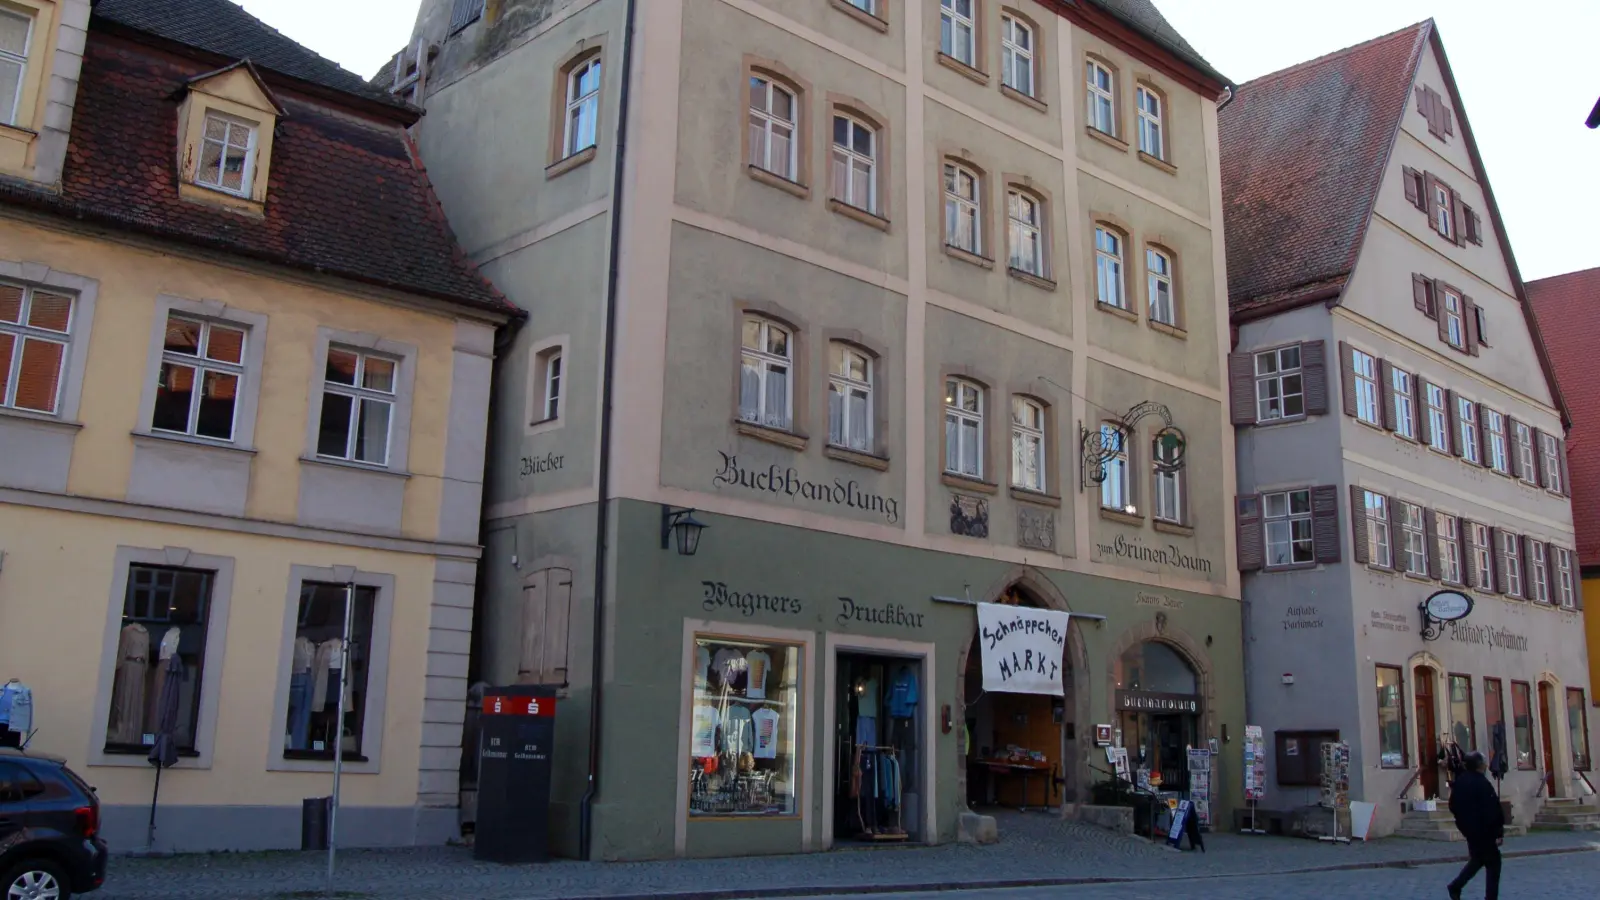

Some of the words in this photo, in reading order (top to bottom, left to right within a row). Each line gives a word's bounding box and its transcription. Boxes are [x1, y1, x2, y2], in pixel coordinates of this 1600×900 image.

[519, 451, 564, 480] Bücher
[712, 450, 898, 524] Buchhandlung
[1096, 543, 1114, 557] zum
[1113, 534, 1167, 565] Grünen
[1167, 544, 1212, 573] Baum
[701, 580, 802, 617] Wagners
[836, 596, 925, 628] Druckbar
[983, 616, 1063, 650] Schnäppchen
[999, 649, 1058, 681] MARKT
[1124, 695, 1196, 712] Buchhandlung
